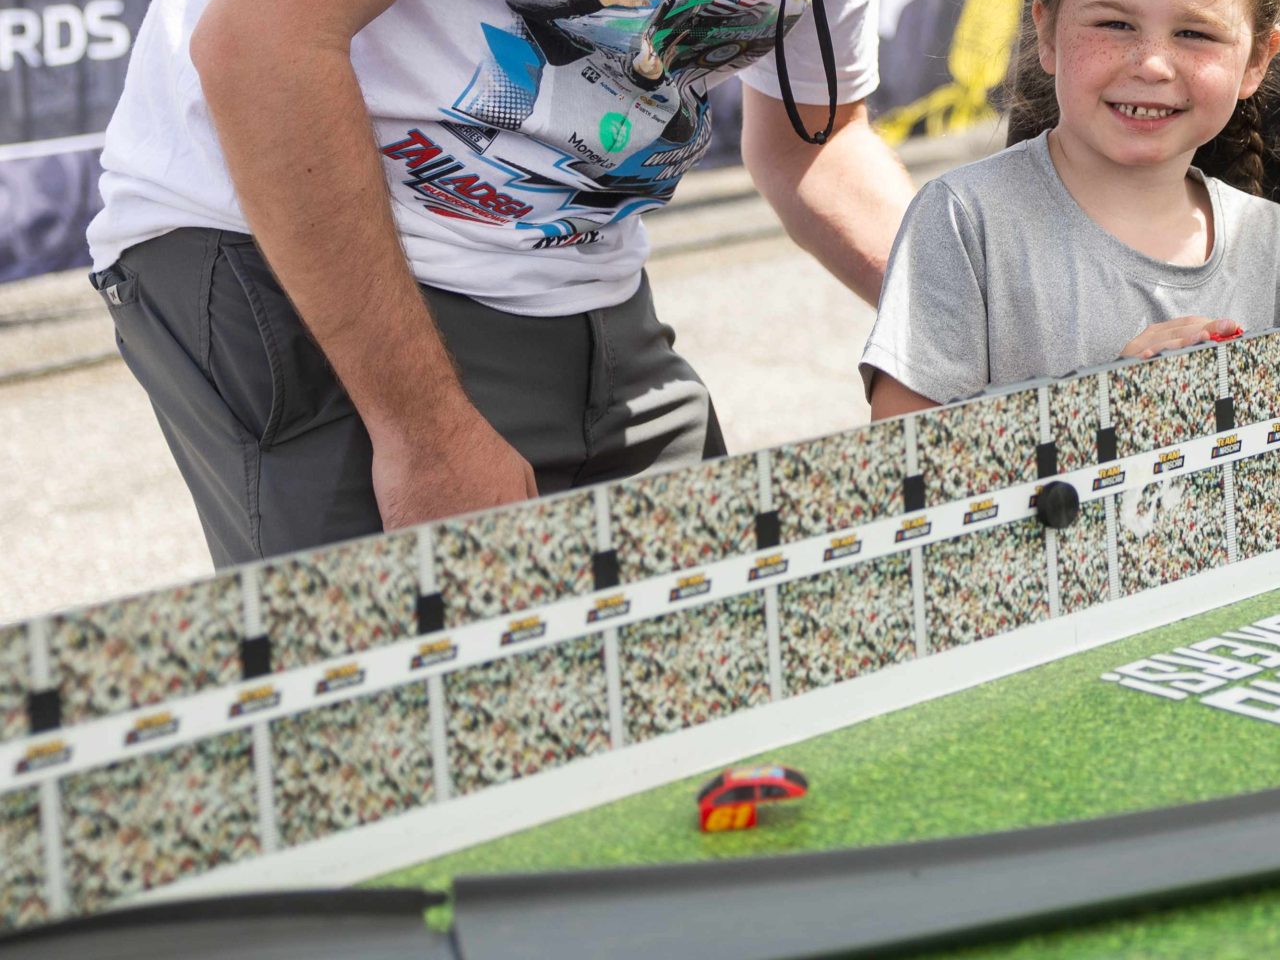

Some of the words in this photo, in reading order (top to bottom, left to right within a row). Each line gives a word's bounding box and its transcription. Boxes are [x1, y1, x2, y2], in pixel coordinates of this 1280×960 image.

[382, 128, 534, 219] TALLADEGA
[1216, 434, 1238, 447] TEAM
[1159, 450, 1181, 463] TEAM
